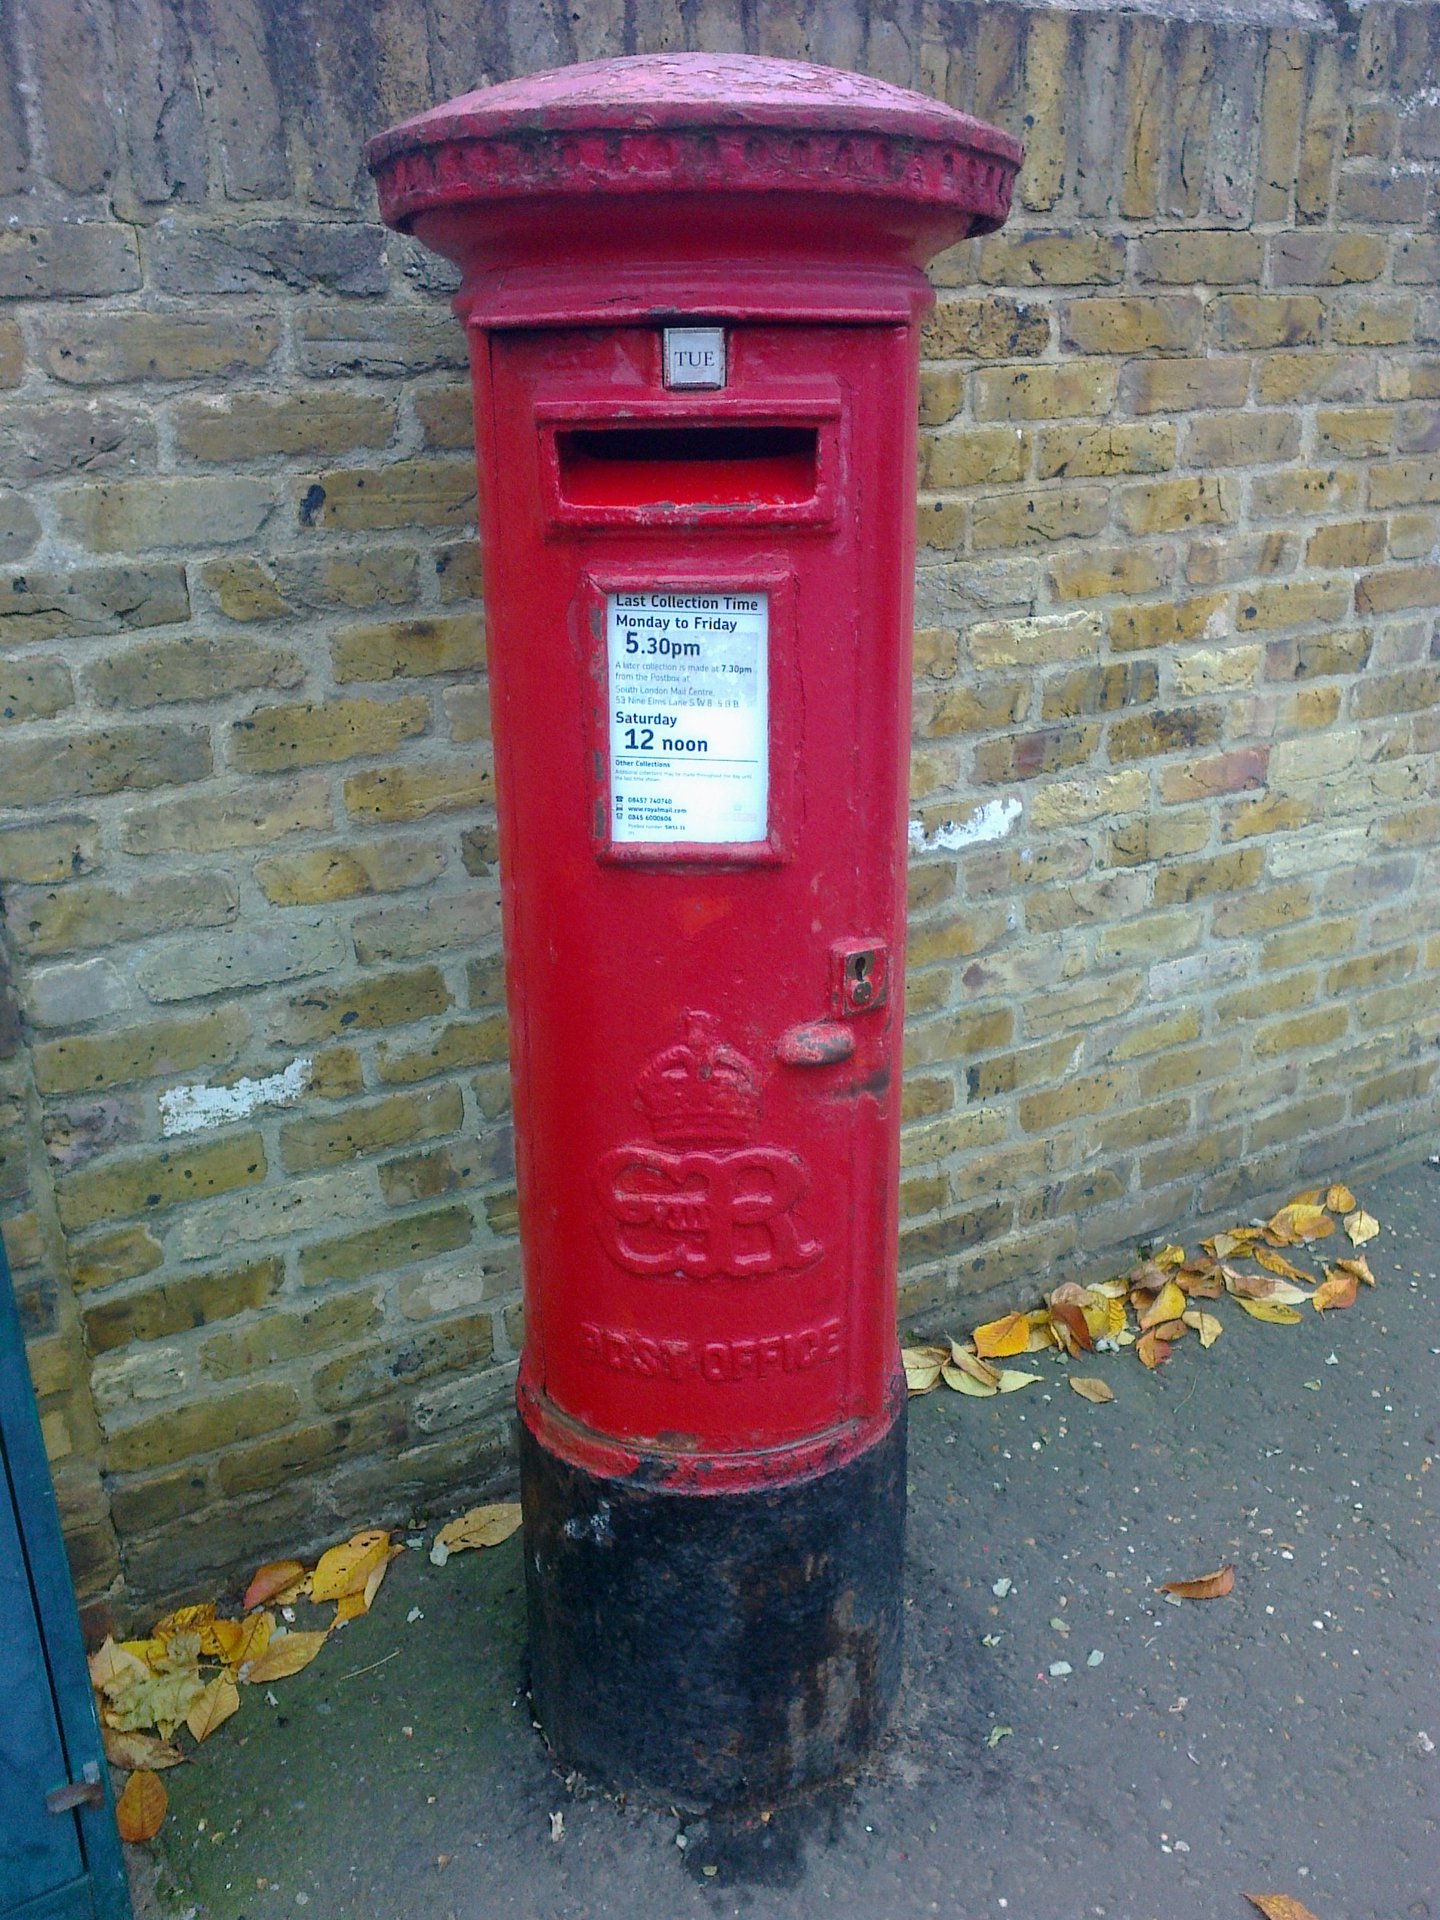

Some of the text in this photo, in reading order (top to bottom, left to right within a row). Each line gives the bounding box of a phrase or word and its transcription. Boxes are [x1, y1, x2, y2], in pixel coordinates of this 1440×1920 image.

[674, 351, 715, 367] TUE
[616, 594, 758, 611] Last Collection Time
[616, 614, 737, 633] Monday to Friday
[626, 630, 701, 659] 5.30pm
[623, 662, 640, 670] later
[642, 663, 677, 671] collection
[688, 664, 710, 672] made
[721, 664, 752, 674] 7.30pm
[616, 673, 633, 681] from
[636, 673, 648, 681] the
[651, 674, 681, 682] Postbox
[615, 685, 638, 694] South
[640, 687, 668, 695] London
[670, 688, 686, 696] Mail
[628, 697, 646, 705] Nine
[647, 698, 666, 706] Elms
[616, 711, 677, 728] Saturday
[624, 728, 708, 752] 12 noon
[615, 759, 671, 768] Other Collections
[628, 806, 687, 814] www.royalmail.com
[701, 1318, 842, 1382] OFFICE
